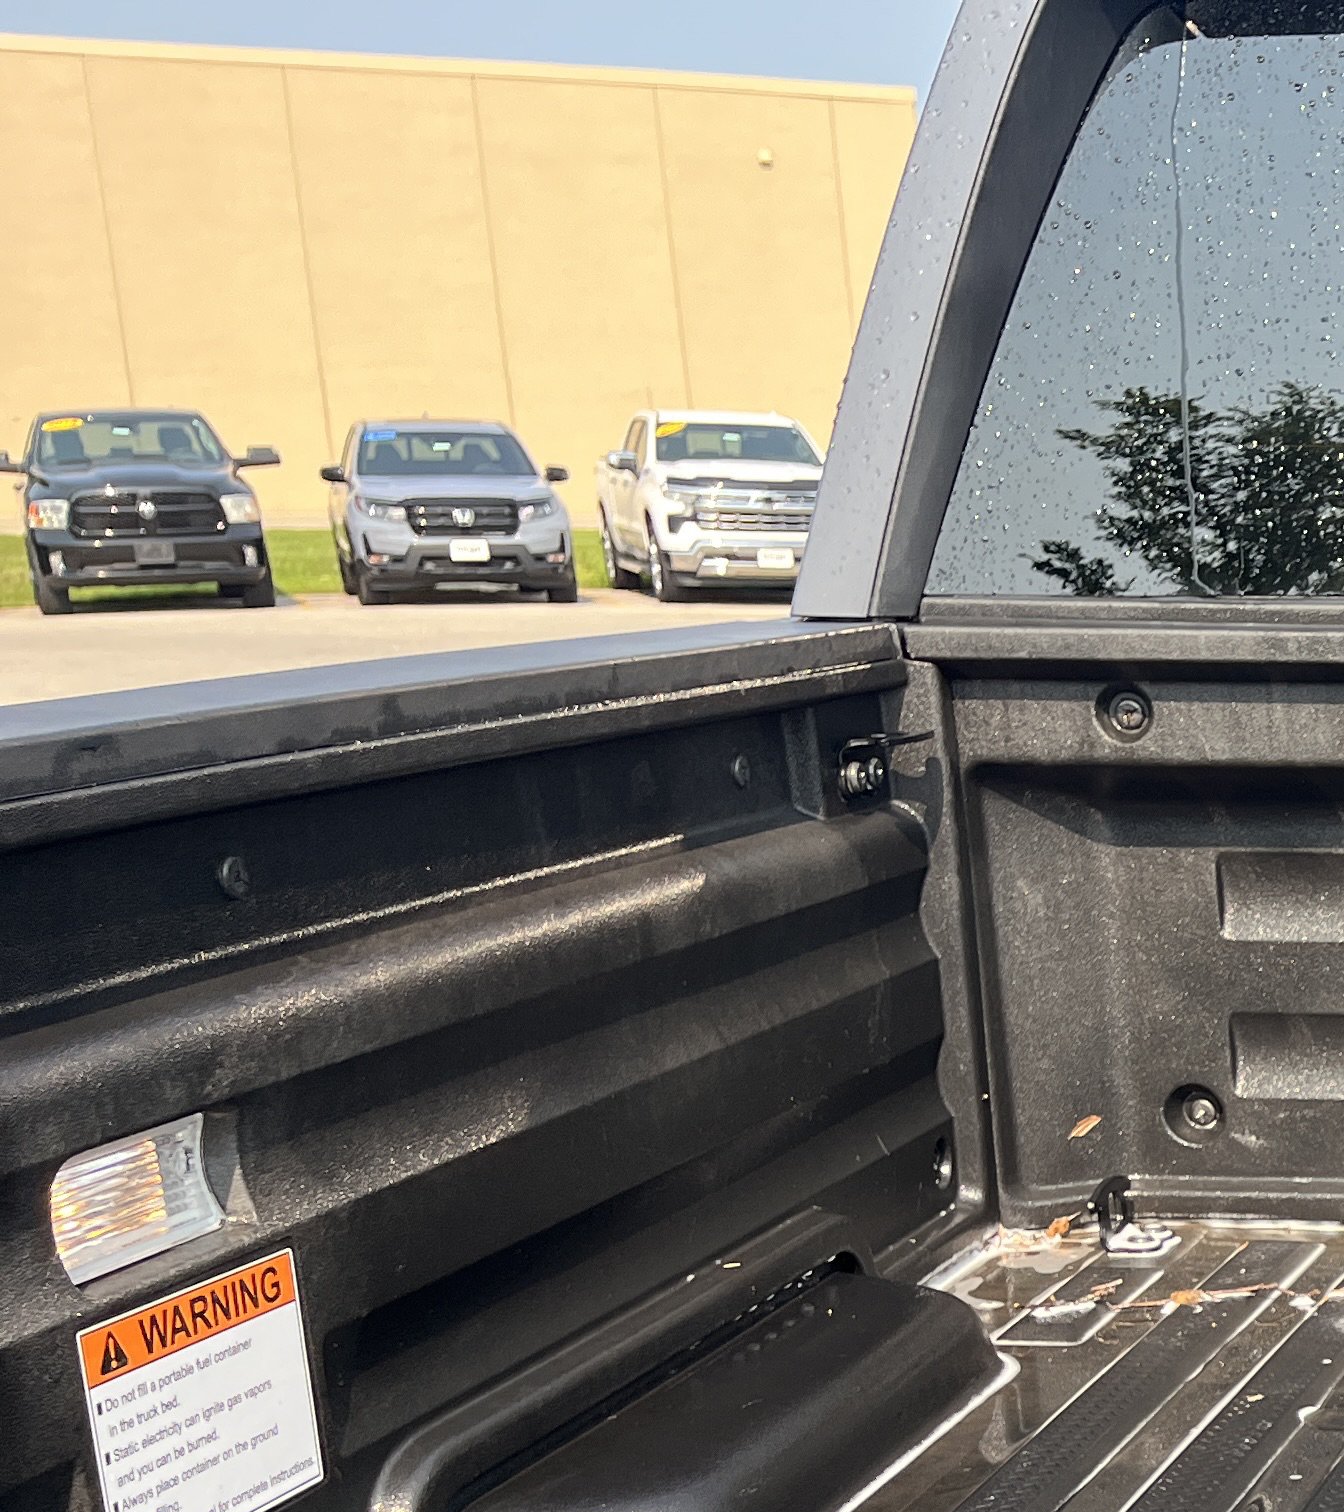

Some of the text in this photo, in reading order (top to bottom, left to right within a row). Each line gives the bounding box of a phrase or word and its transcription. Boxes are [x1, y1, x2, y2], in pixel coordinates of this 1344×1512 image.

[138, 1266, 281, 1354] WARNING
[105, 1398, 119, 1413] Do
[122, 1390, 136, 1405] not
[137, 1381, 149, 1398] fill
[158, 1364, 195, 1392] portable
[196, 1354, 213, 1370] fuel
[214, 1338, 252, 1364] container
[109, 1395, 181, 1437] in the truck bed.
[114, 1379, 273, 1462] Static electricity can ignite gas vapors
[117, 1428, 220, 1488] and you can be burned.
[122, 1423, 279, 1512] Always place container on the ground
[218, 1499, 230, 1512] for
[231, 1479, 268, 1507] complete
